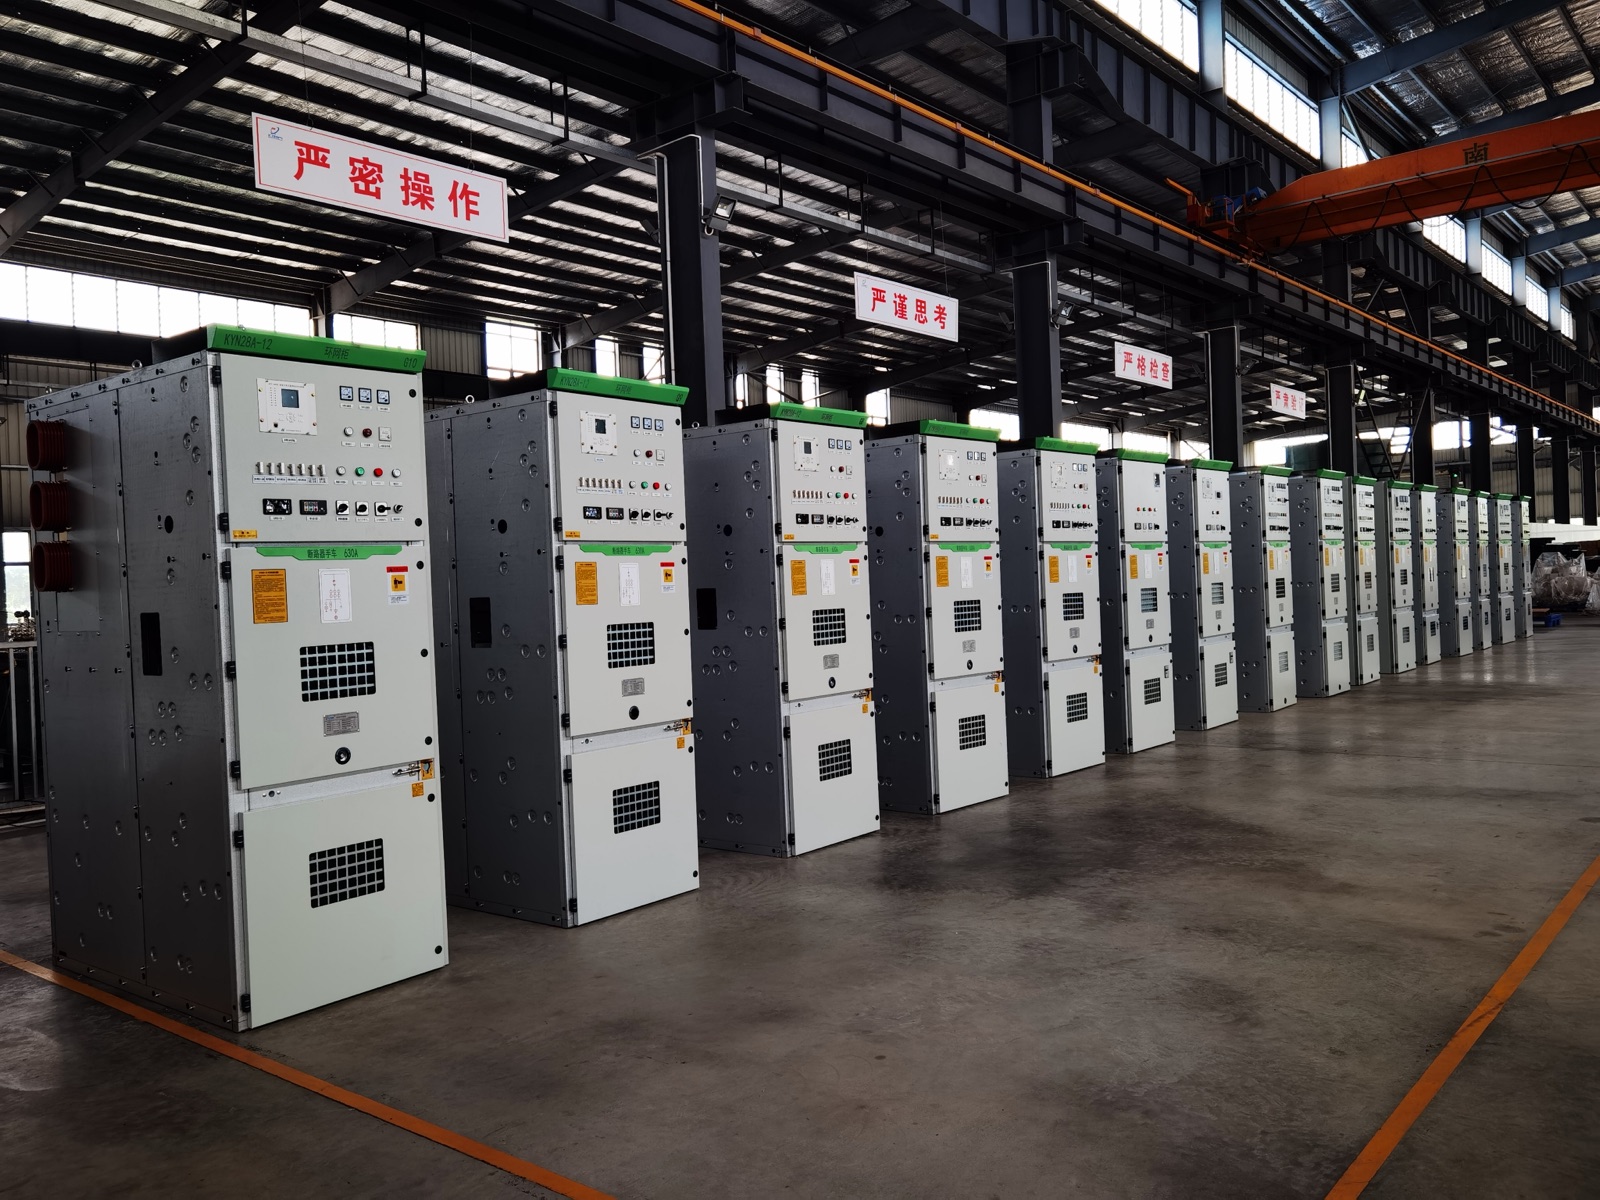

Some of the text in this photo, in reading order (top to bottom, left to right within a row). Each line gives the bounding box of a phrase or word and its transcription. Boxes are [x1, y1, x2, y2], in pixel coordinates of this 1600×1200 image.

[1462, 142, 1490, 165] 南
[293, 140, 481, 222] 严密操作
[871, 286, 948, 330] 严谨思考
[223, 333, 273, 350] KYN28A-12
[403, 357, 418, 369] G10
[1122, 350, 1170, 382] 严格检查
[343, 547, 359, 558] 630A
